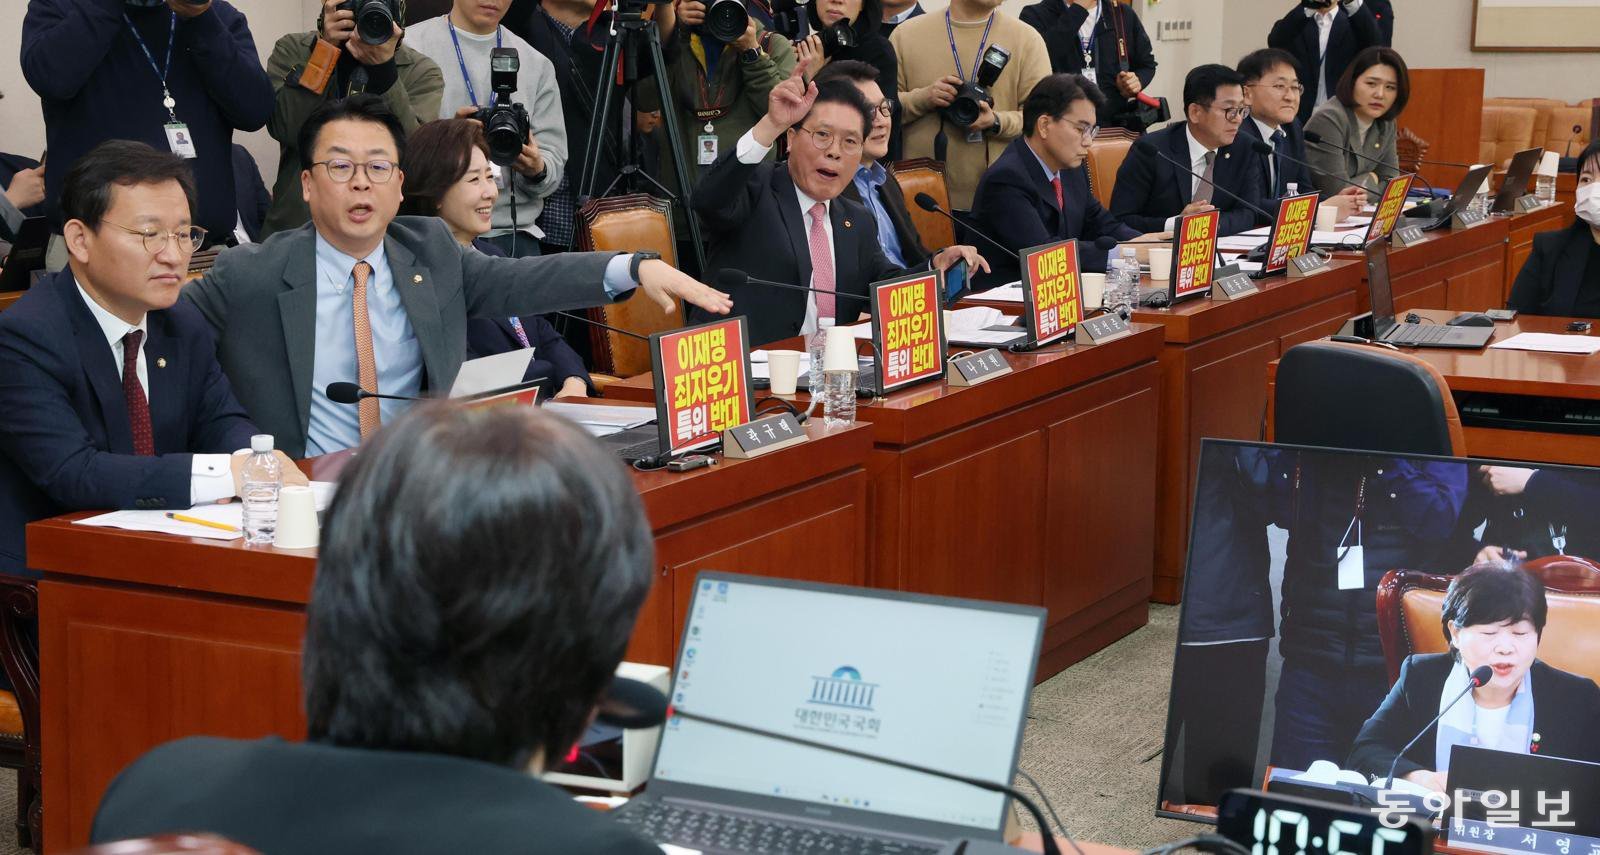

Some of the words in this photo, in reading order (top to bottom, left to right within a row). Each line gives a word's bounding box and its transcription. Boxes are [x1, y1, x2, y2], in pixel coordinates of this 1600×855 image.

[697, 109, 721, 117] Canon
[1186, 215, 1211, 241] 이재명
[1037, 246, 1068, 281] 이재명
[1180, 238, 1213, 267] 죄지우기
[889, 282, 926, 318] 이재명
[1036, 271, 1076, 311] 죄지우기
[886, 311, 934, 351] 죄지우기
[1039, 306, 1059, 336] 특위
[1059, 298, 1078, 329] 반대
[677, 327, 727, 370] 이재명
[887, 347, 910, 379] 특위
[912, 341, 935, 374] 반대
[674, 360, 739, 410] 죄지우기
[676, 404, 708, 441] 특위
[710, 395, 740, 433] 반대
[794, 707, 882, 733] 대한민국국회
[1454, 825, 1496, 841] 위원장
